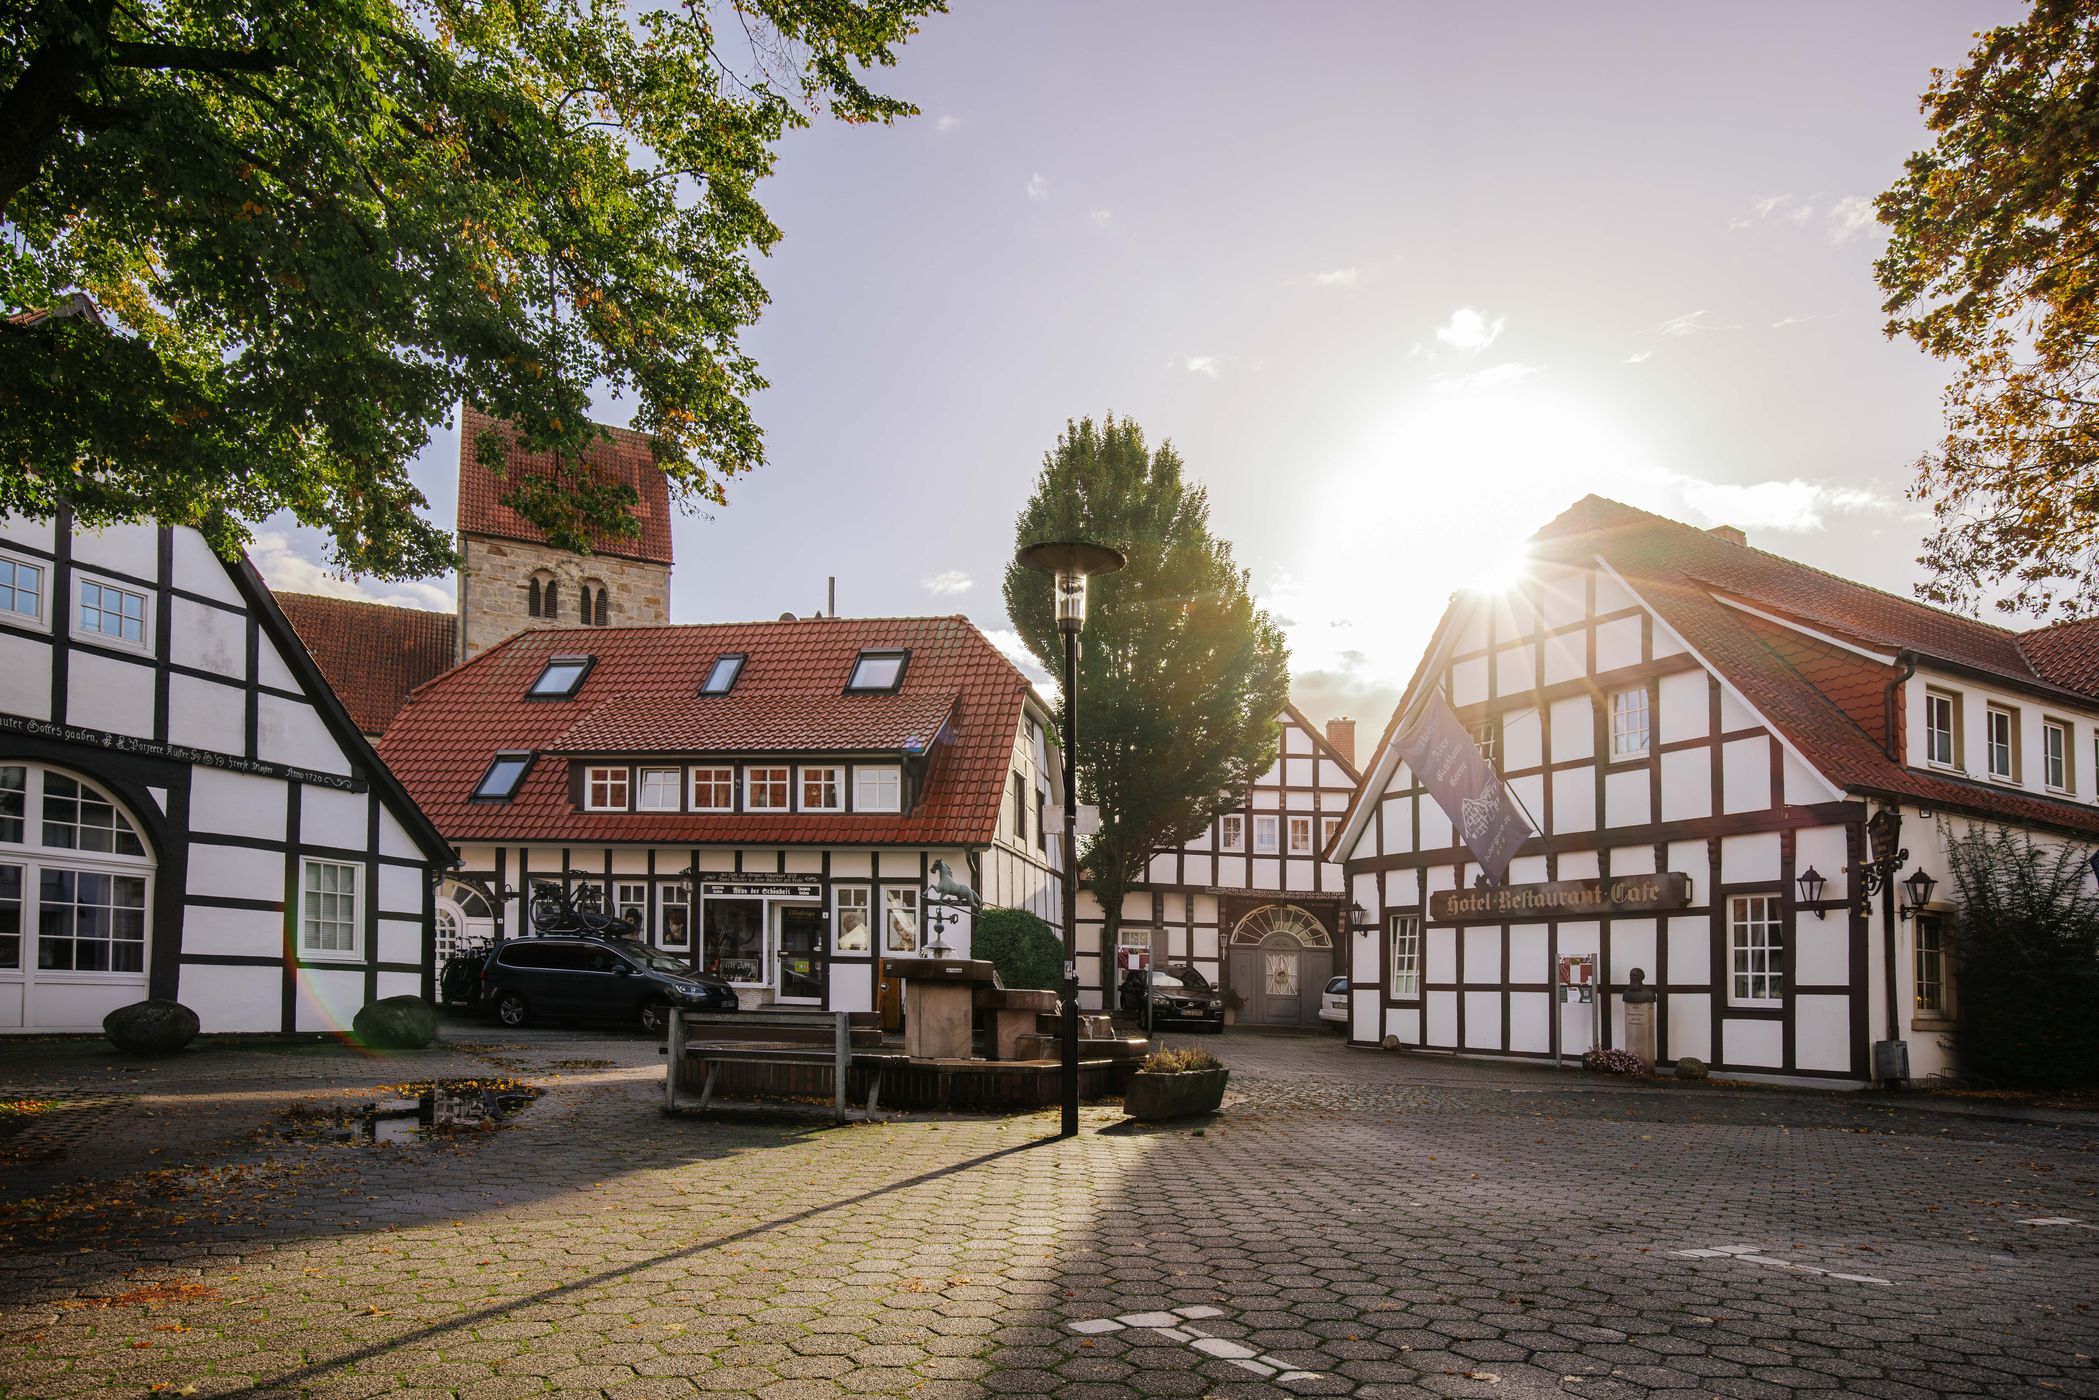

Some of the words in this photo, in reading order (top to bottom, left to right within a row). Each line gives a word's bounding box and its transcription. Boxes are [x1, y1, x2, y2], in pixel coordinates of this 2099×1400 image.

[286, 768, 304, 779] Anno
[305, 772, 322, 783] 1720
[732, 886, 748, 895] Haus
[750, 887, 759, 895] der
[762, 887, 791, 895] Schönheit
[1447, 892, 1491, 916] Hotel
[1499, 886, 1602, 913] Restaurant
